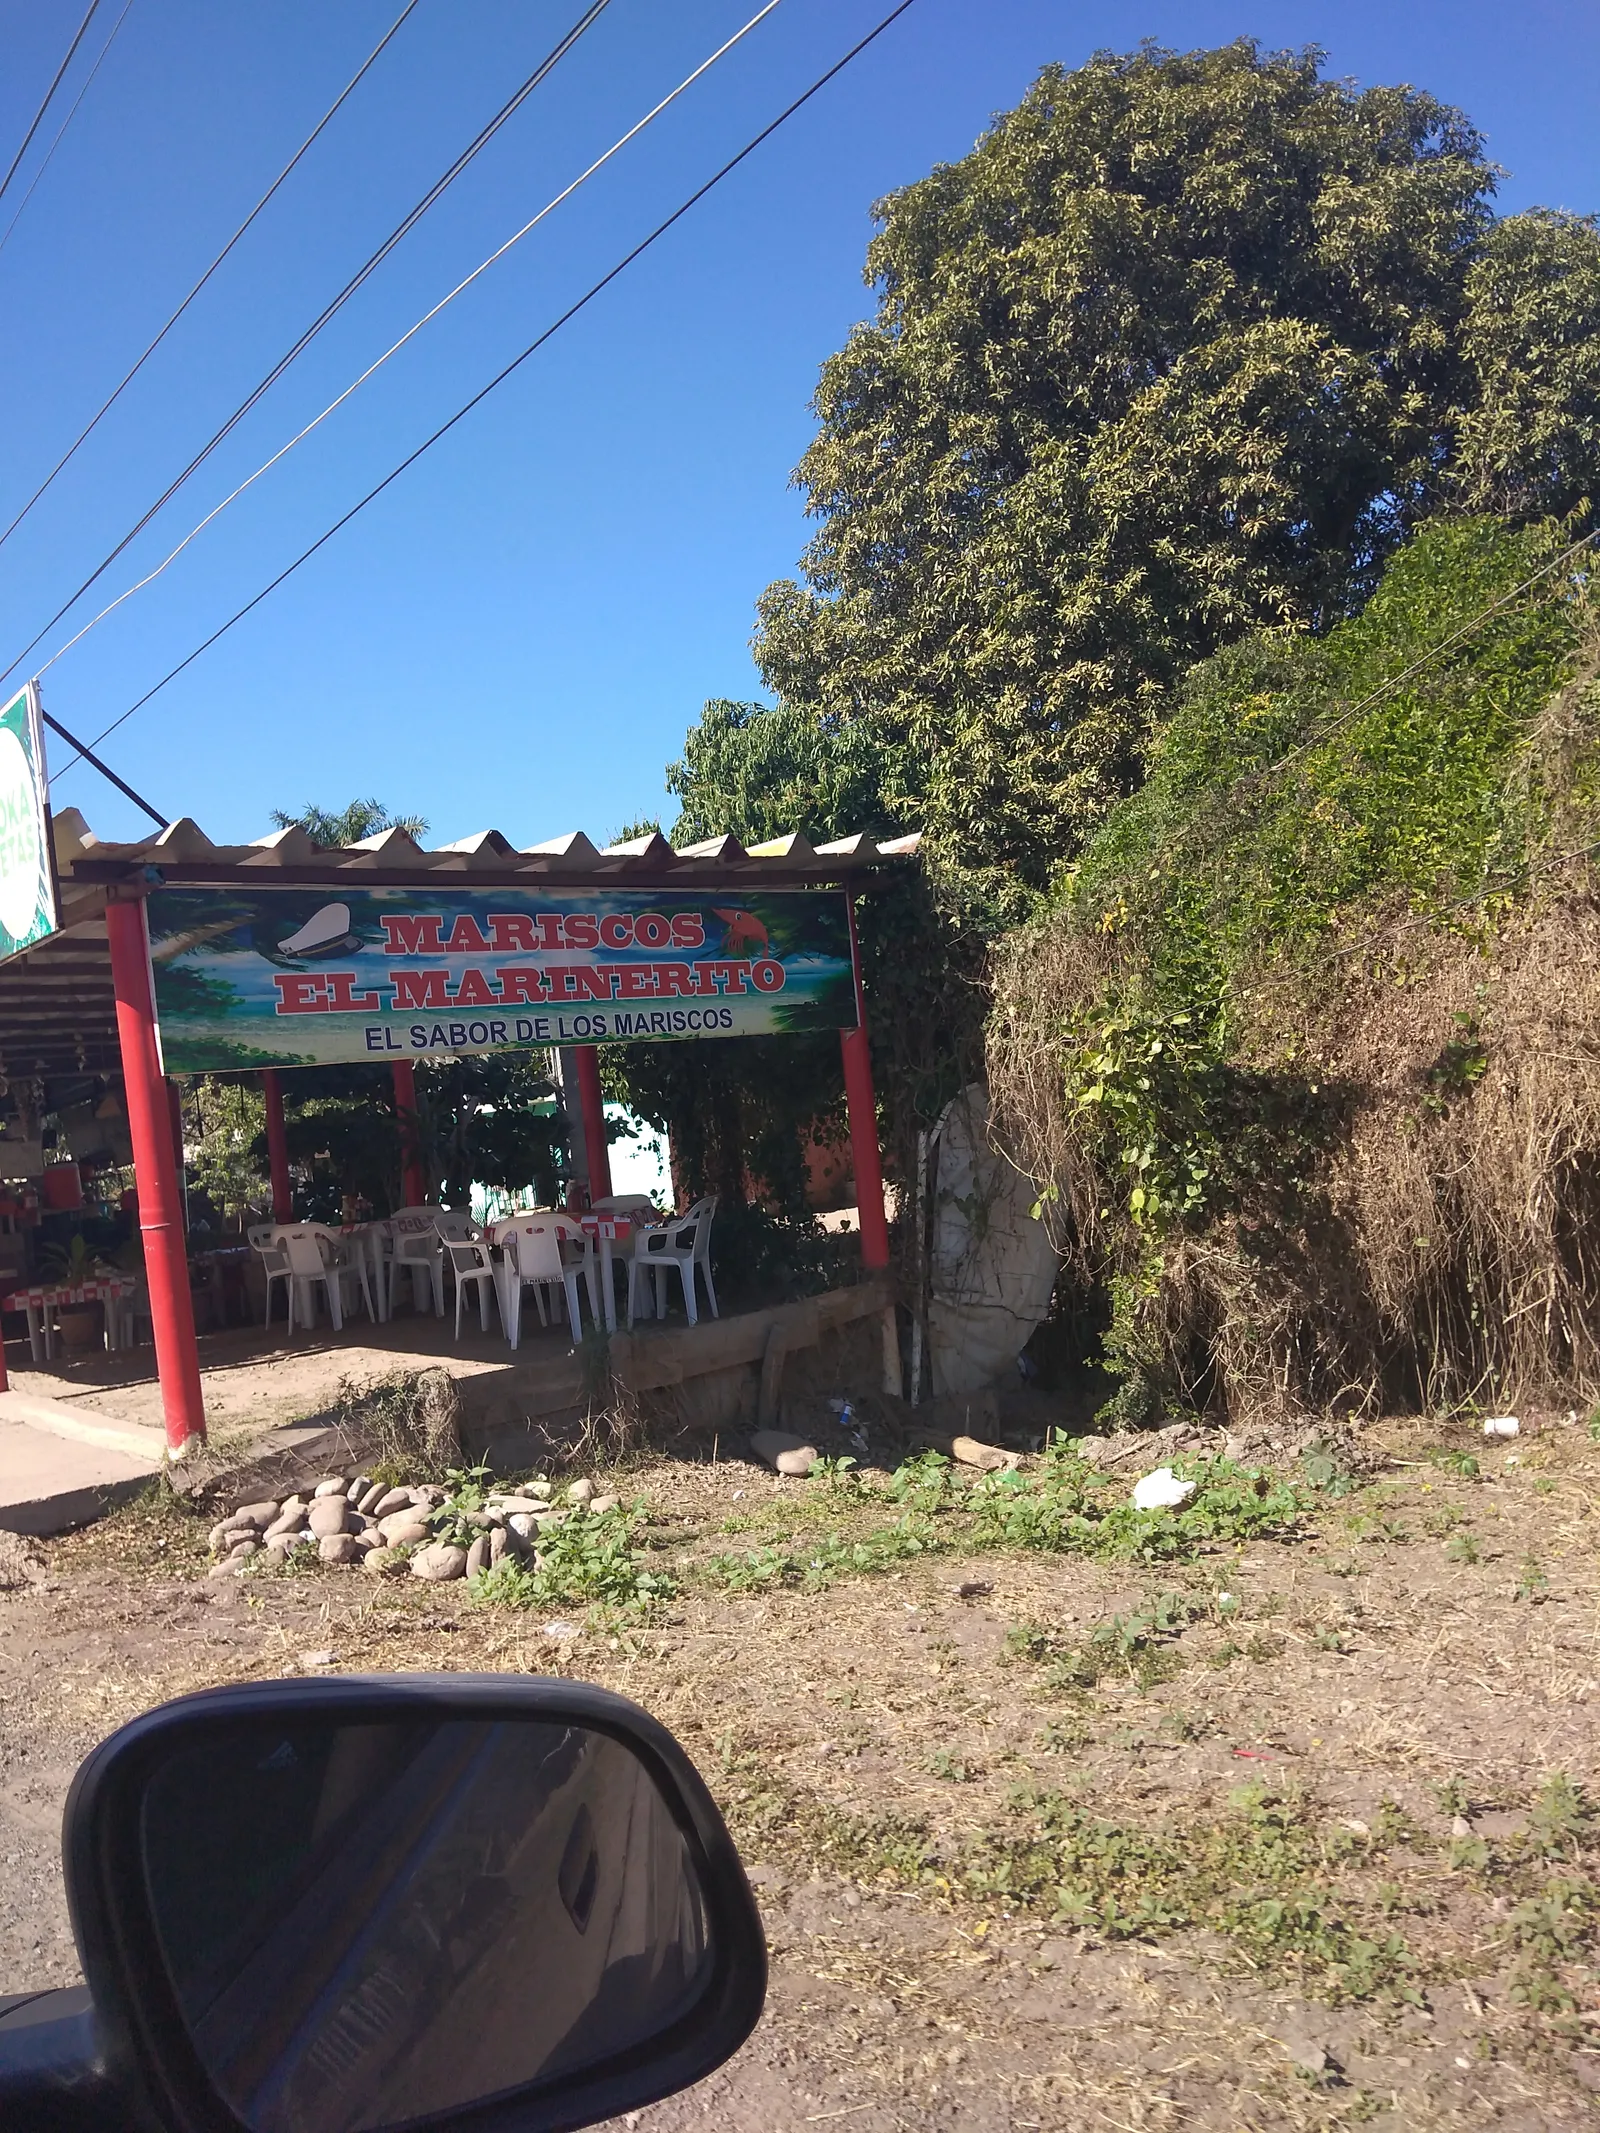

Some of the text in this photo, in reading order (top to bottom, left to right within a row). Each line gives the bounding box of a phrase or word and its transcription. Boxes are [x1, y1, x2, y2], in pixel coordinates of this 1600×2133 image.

[381, 913, 705, 954] MARISCOS
[273, 959, 785, 1015] EL MARINERITO
[365, 1008, 733, 1051] EL SABOR DE LOS MARISCOS
